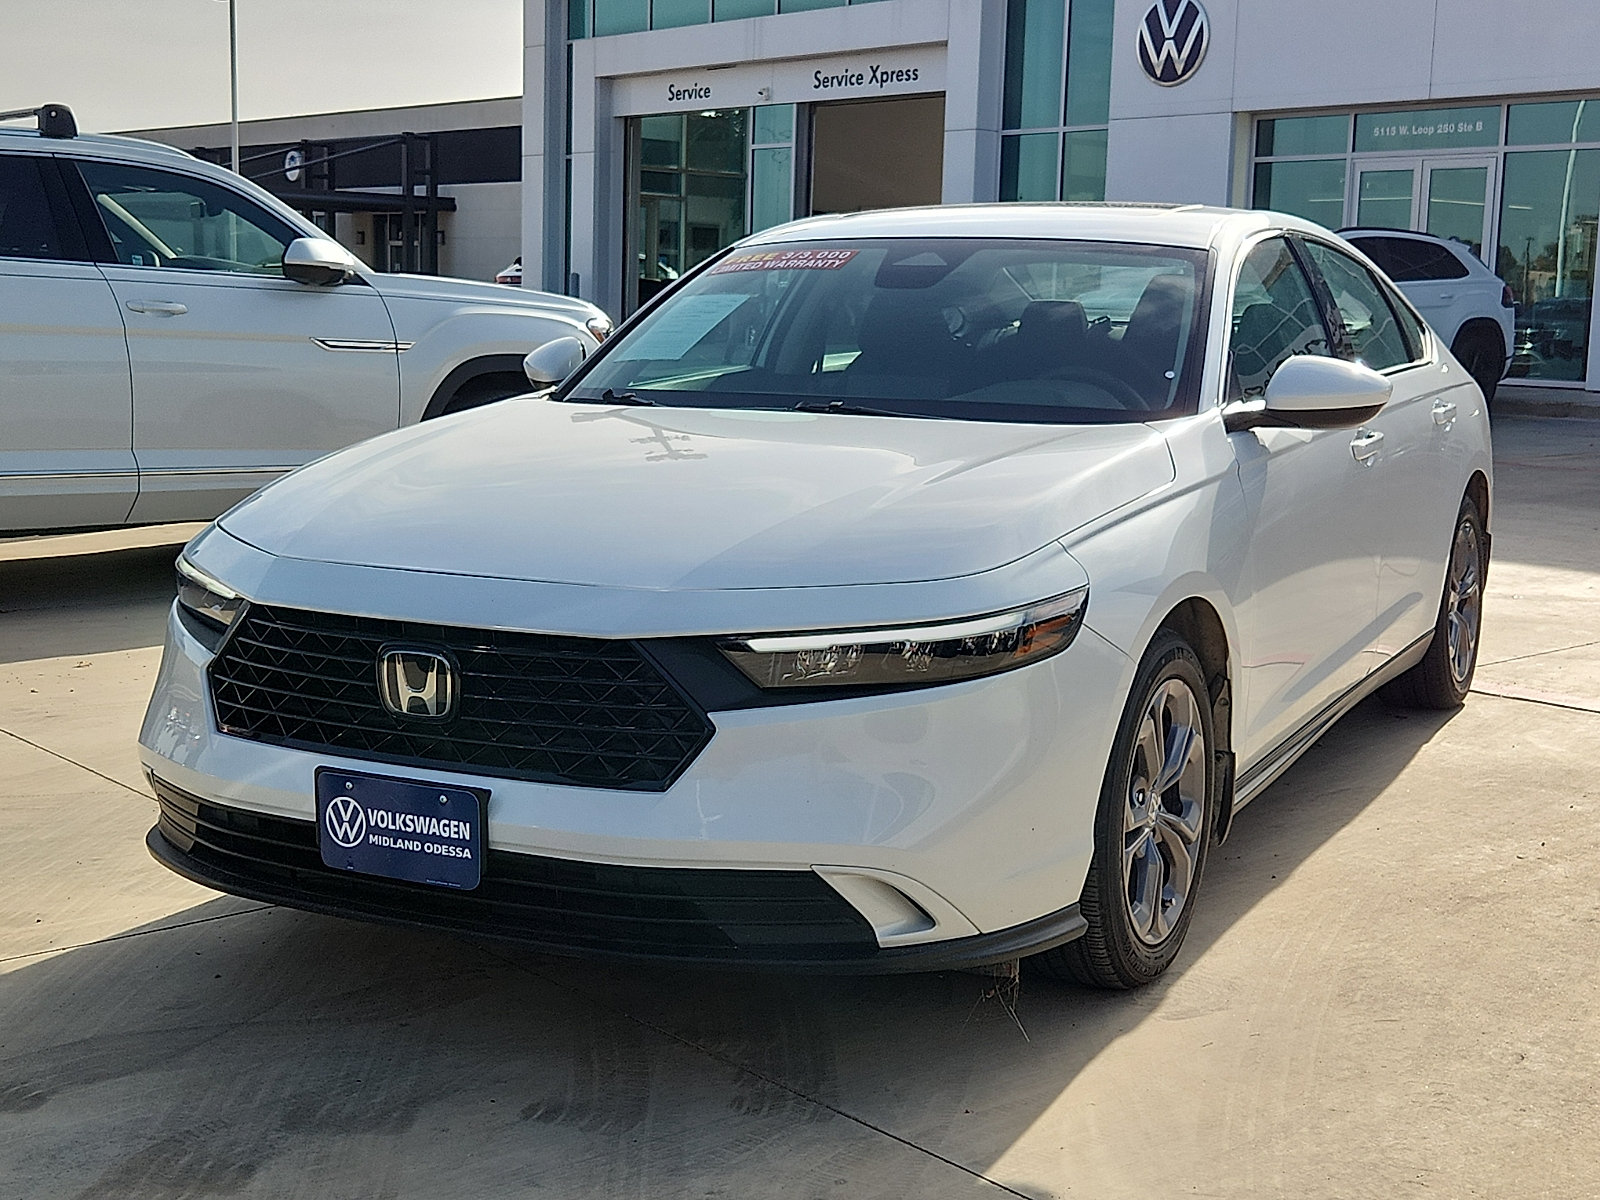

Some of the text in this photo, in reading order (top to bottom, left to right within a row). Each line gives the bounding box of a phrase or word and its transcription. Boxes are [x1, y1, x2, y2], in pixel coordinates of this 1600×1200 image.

[813, 65, 919, 89] Service Xpress
[668, 82, 711, 101] Service
[1412, 125, 1434, 136] Loop
[1437, 123, 1455, 134] 250
[1457, 122, 1473, 132] Ste
[1475, 121, 1483, 131] B
[711, 259, 845, 274] LIMITED WARRANTY
[724, 252, 779, 264] FREE
[367, 808, 470, 841] VOLKSWAGEN
[368, 834, 472, 860] MIDLAND ODESSA
